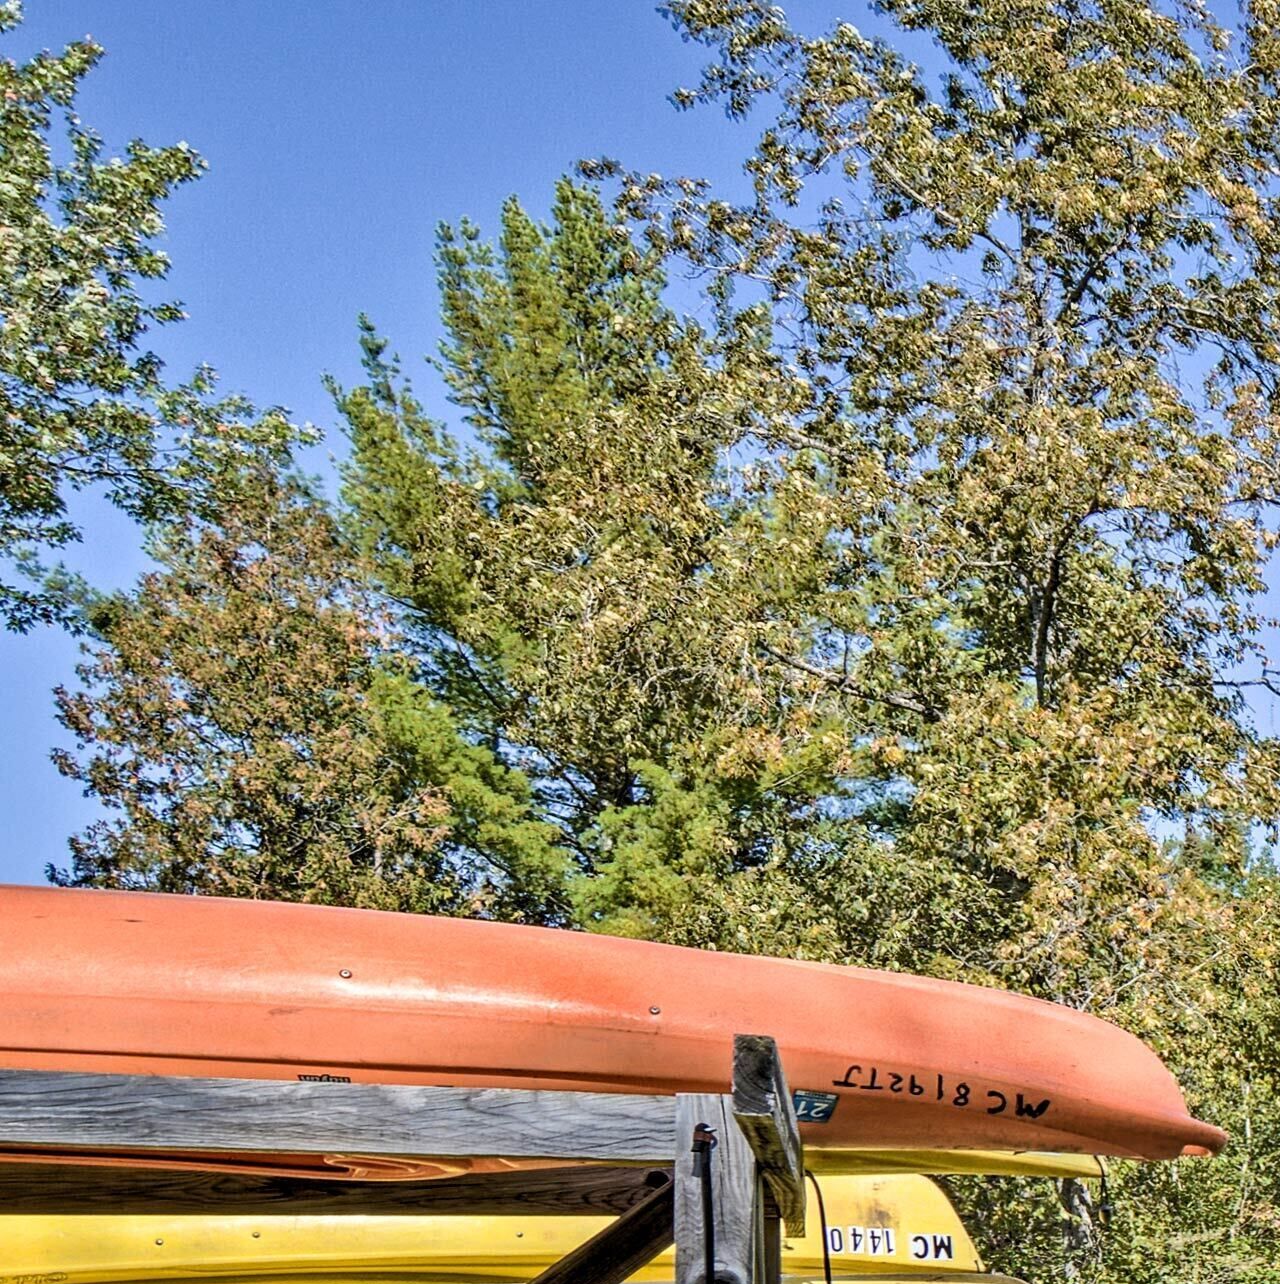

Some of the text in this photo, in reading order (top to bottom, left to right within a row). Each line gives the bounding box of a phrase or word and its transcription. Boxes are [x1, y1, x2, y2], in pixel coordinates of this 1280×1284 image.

[796, 1101, 829, 1117] 21
[987, 1091, 1050, 1119] MC
[831, 1228, 953, 1260] MC 1440
